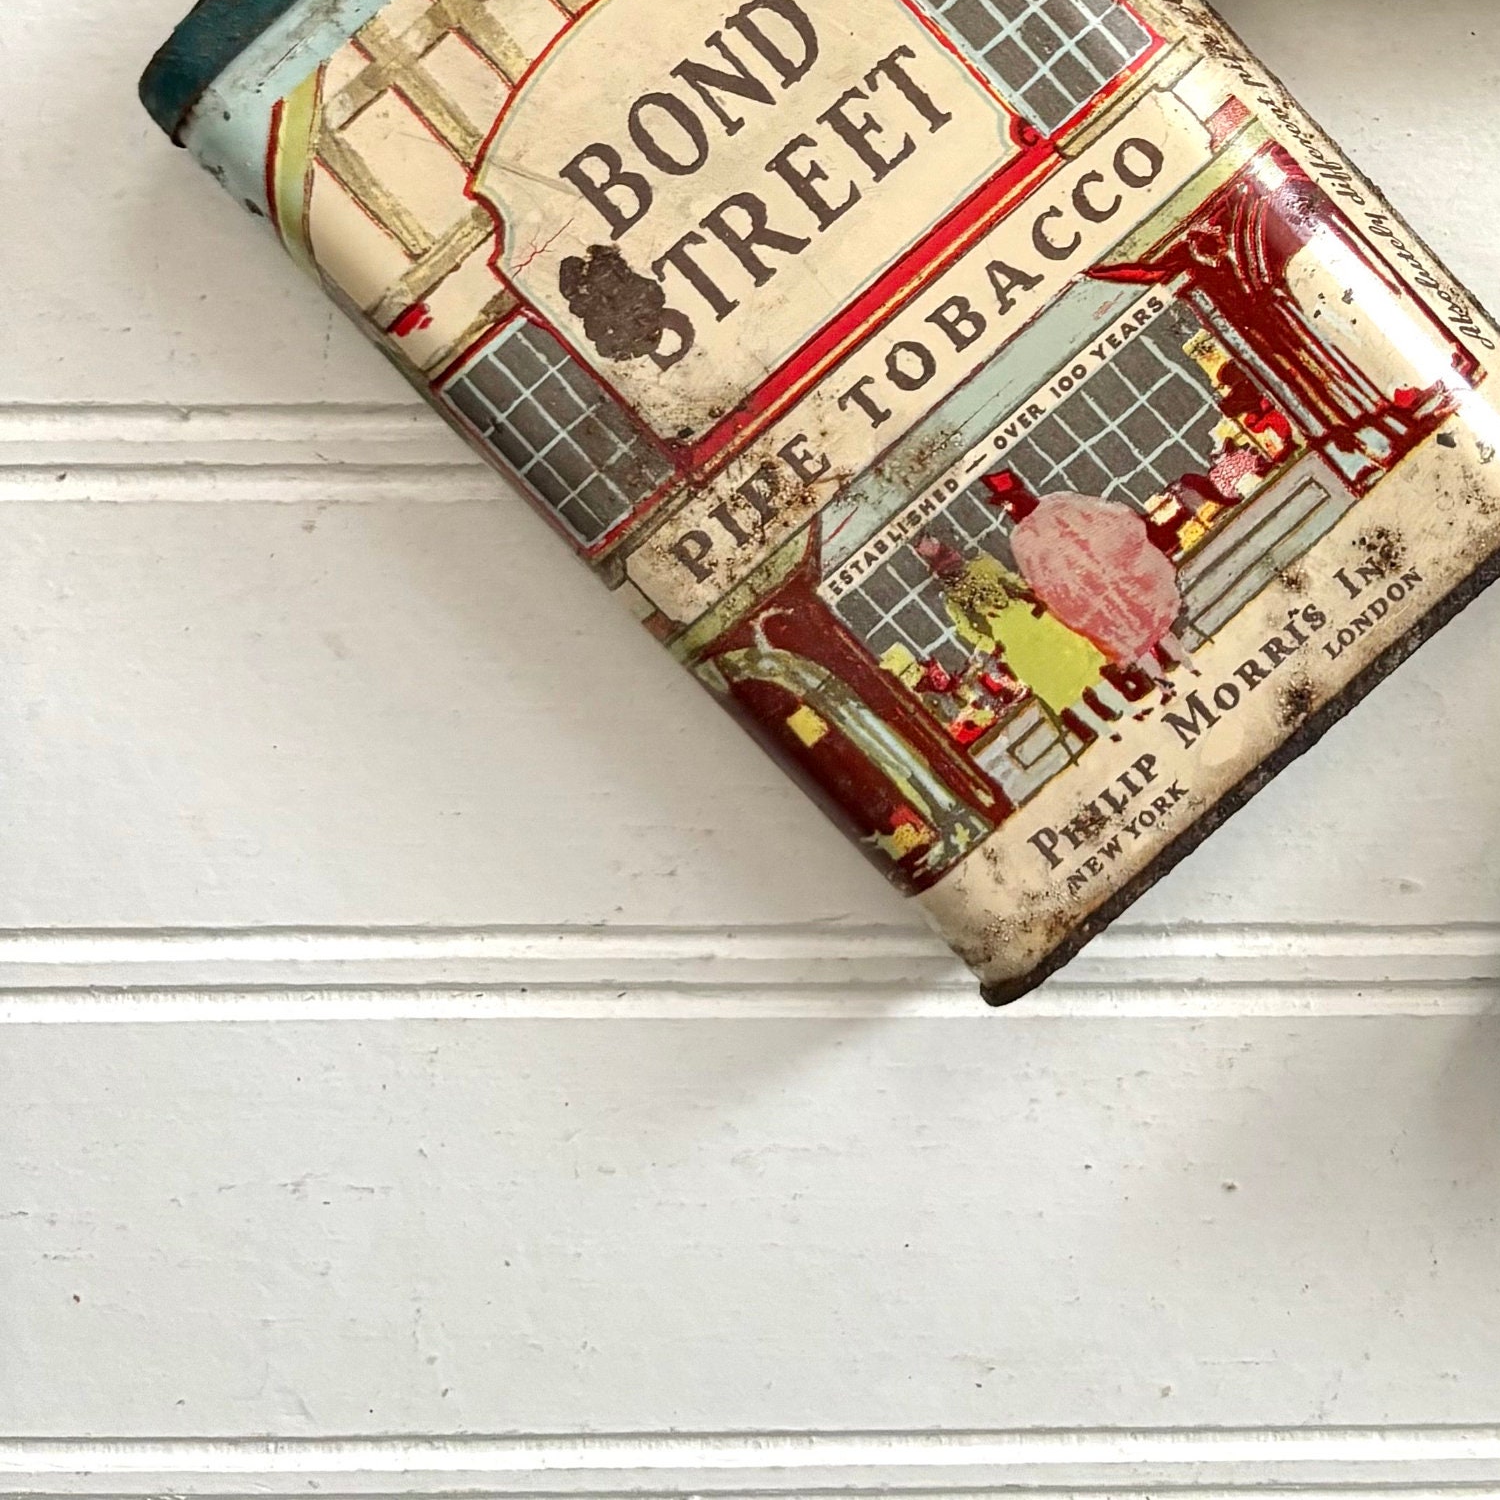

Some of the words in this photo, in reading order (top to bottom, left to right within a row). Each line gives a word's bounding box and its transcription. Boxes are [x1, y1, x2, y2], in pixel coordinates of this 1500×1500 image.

[1257, 95, 1365, 206] different
[1365, 211, 1495, 351] Absolutely
[670, 433, 833, 584] PIPE
[837, 137, 1165, 429] TOBACCO
[828, 477, 959, 596] ESTABLISHED
[993, 404, 1046, 450] OVER
[1049, 364, 1088, 399] 100
[1090, 295, 1165, 362] YEARS
[1322, 565, 1424, 660] LONDON
[1026, 752, 1158, 870] PHILIP
[1160, 603, 1328, 749] MORRIS
[1067, 836, 1124, 894] NEW
[1123, 779, 1189, 841] YORK
